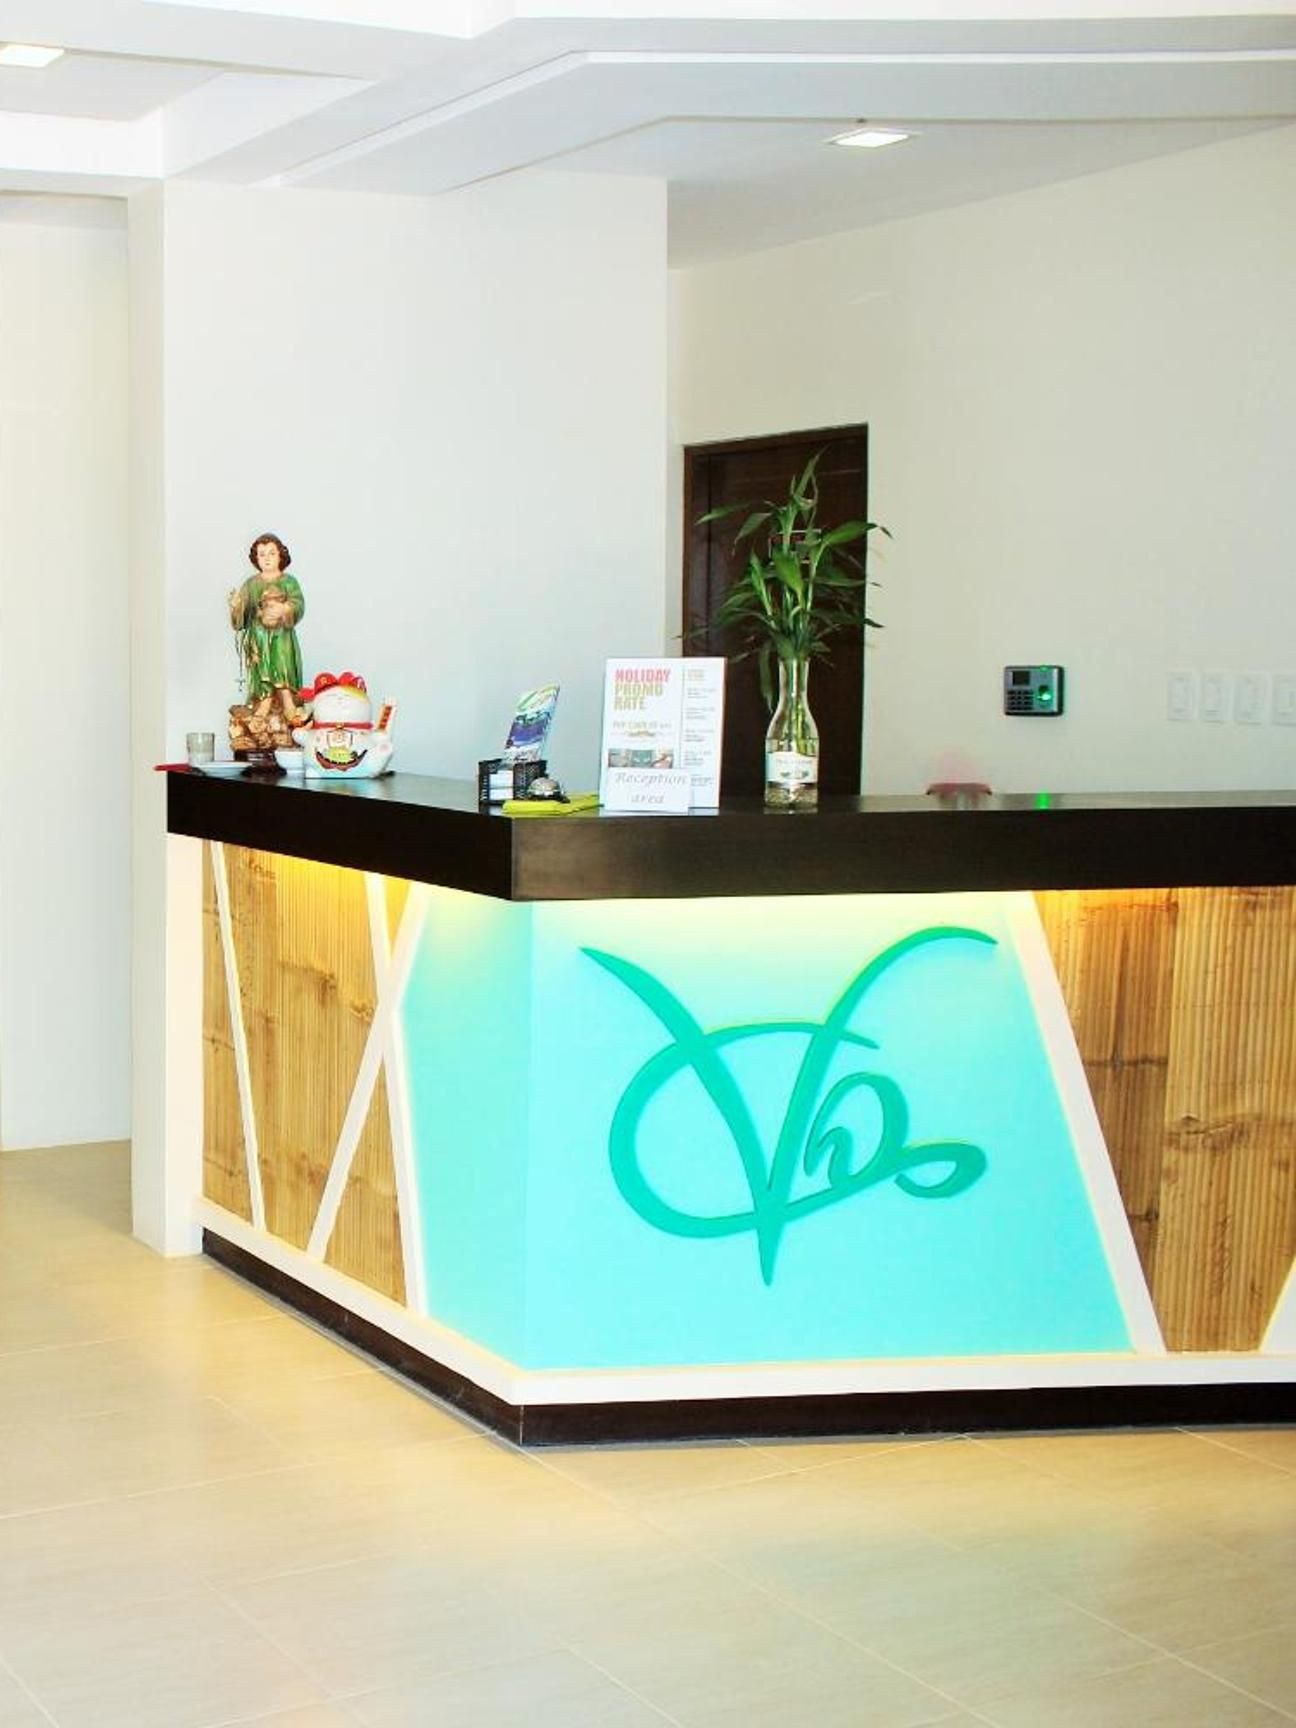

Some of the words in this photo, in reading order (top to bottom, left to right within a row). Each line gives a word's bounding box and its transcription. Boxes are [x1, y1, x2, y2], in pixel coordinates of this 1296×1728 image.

[614, 668, 671, 682] HOLIDAY
[614, 682, 664, 697] PROMO
[613, 696, 647, 711] RATE
[614, 772, 688, 787] Reception
[630, 793, 666, 805] area
